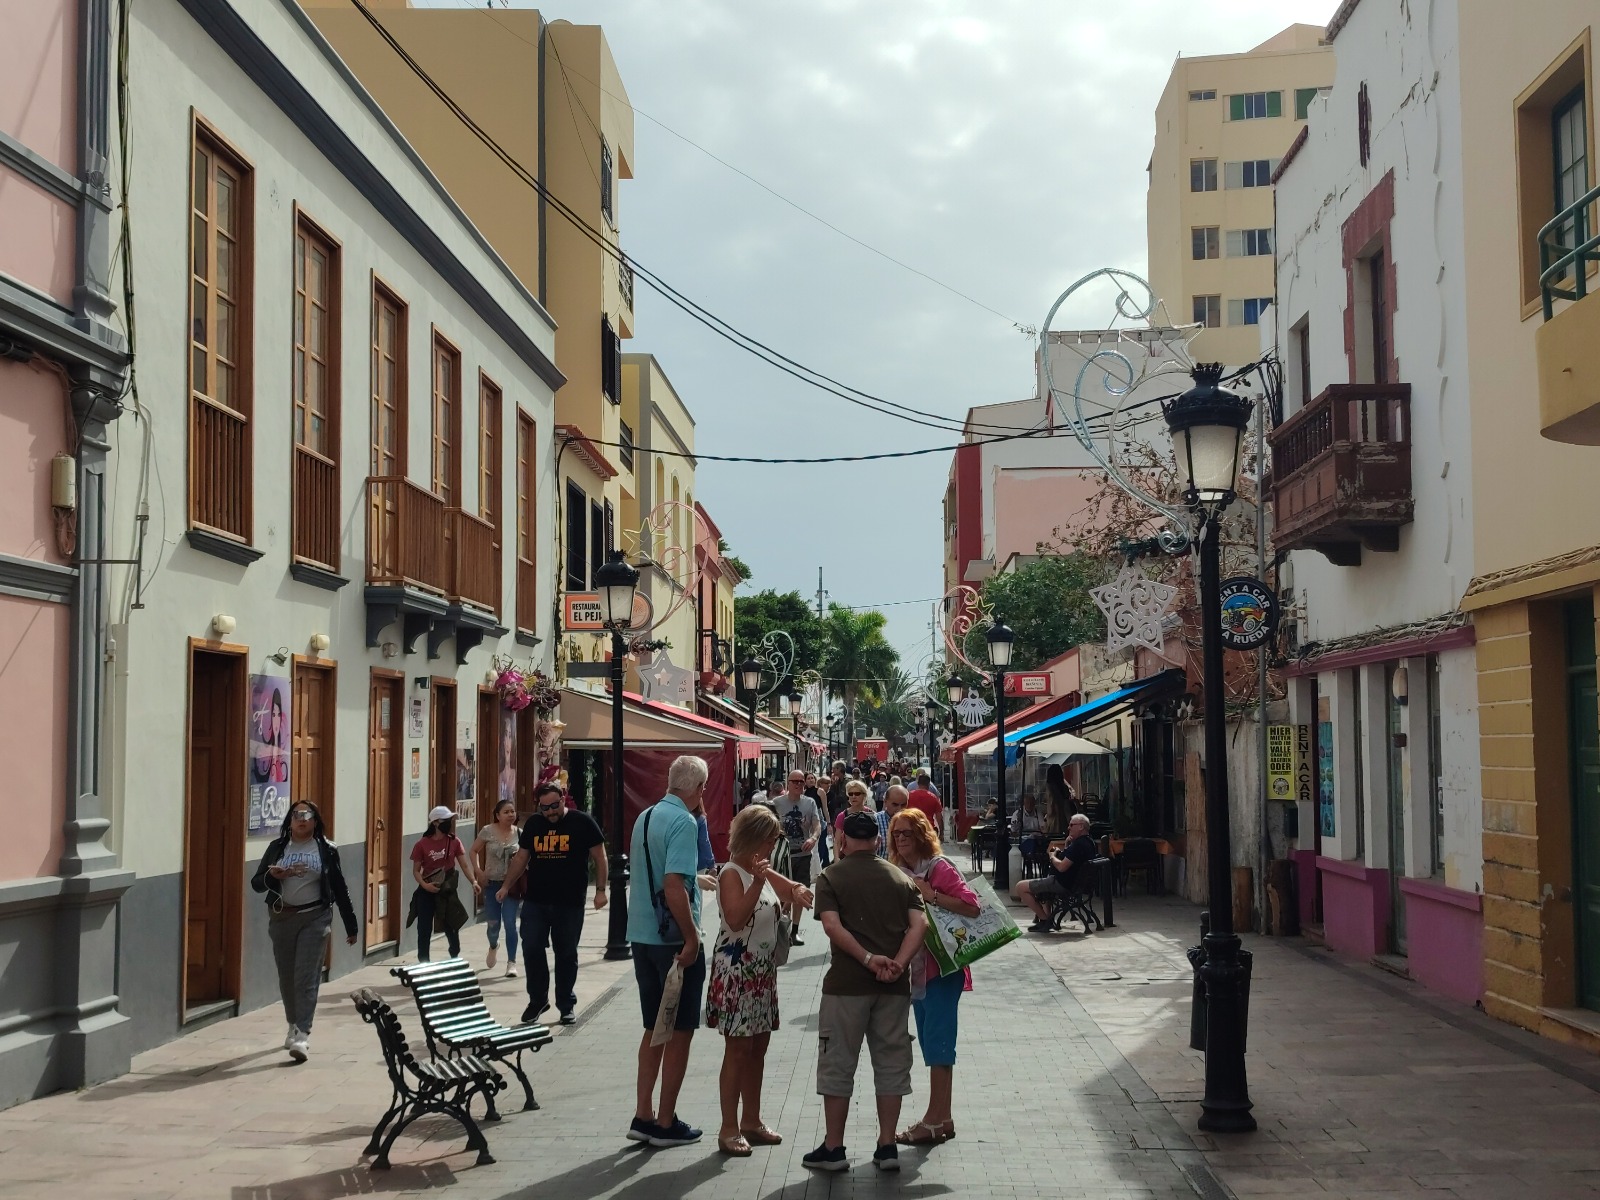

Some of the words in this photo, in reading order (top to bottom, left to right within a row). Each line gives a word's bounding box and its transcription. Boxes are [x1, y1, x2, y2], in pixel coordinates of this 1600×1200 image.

[1220, 585, 1238, 604] ENT
[1241, 584, 1250, 593] A
[1252, 589, 1271, 609] CAR
[571, 603, 601, 611] RESTAURA
[573, 611, 583, 622] EL
[1233, 625, 1270, 644] RUEDA
[1270, 727, 1291, 736] HIER
[1298, 724, 1309, 760] RENT
[1270, 763, 1291, 771] ODER
[1299, 762, 1310, 772] A
[1298, 774, 1311, 801] CAR
[533, 834, 570, 852] LIFE
